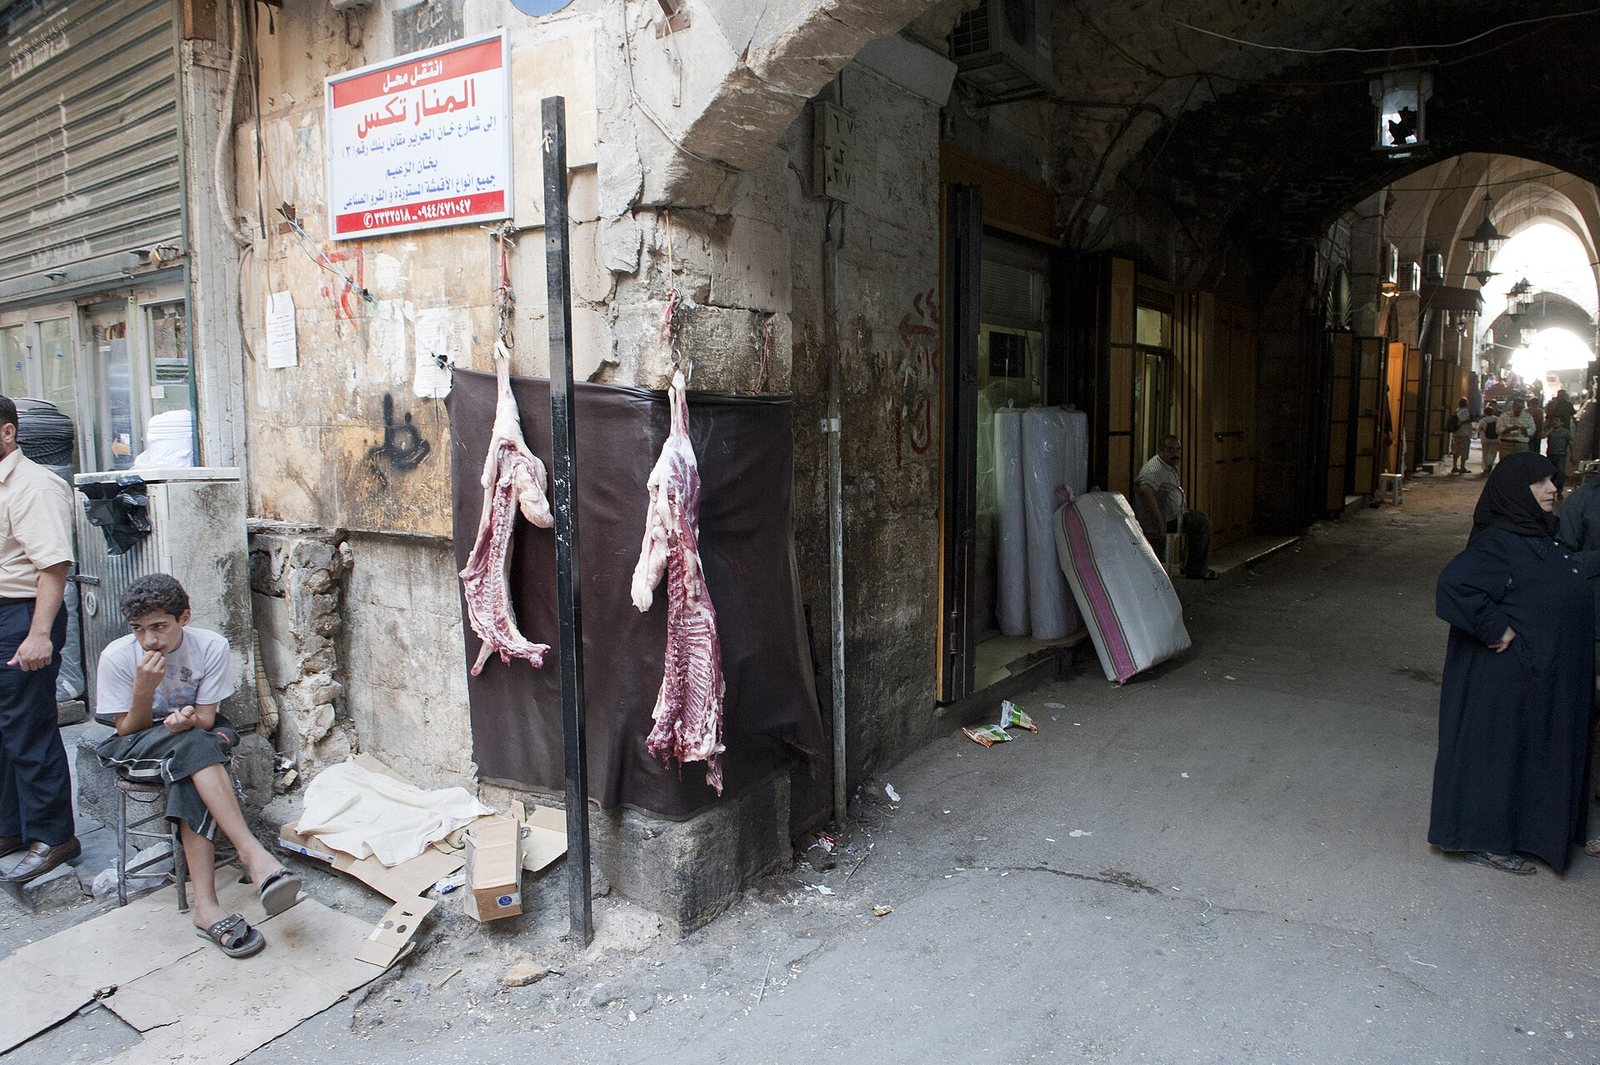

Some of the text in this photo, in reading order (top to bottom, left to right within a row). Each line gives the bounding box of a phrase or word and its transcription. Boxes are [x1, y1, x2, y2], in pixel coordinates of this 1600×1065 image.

[383, 60, 443, 93] انتقل محل
[357, 78, 476, 140] المنار تكس
[437, 122, 455, 141] خان
[458, 114, 481, 138] شارع
[387, 133, 406, 152] مقابل
[408, 129, 436, 148] الحرير
[386, 156, 438, 180] بخان الزعيم
[476, 174, 496, 192] جميع
